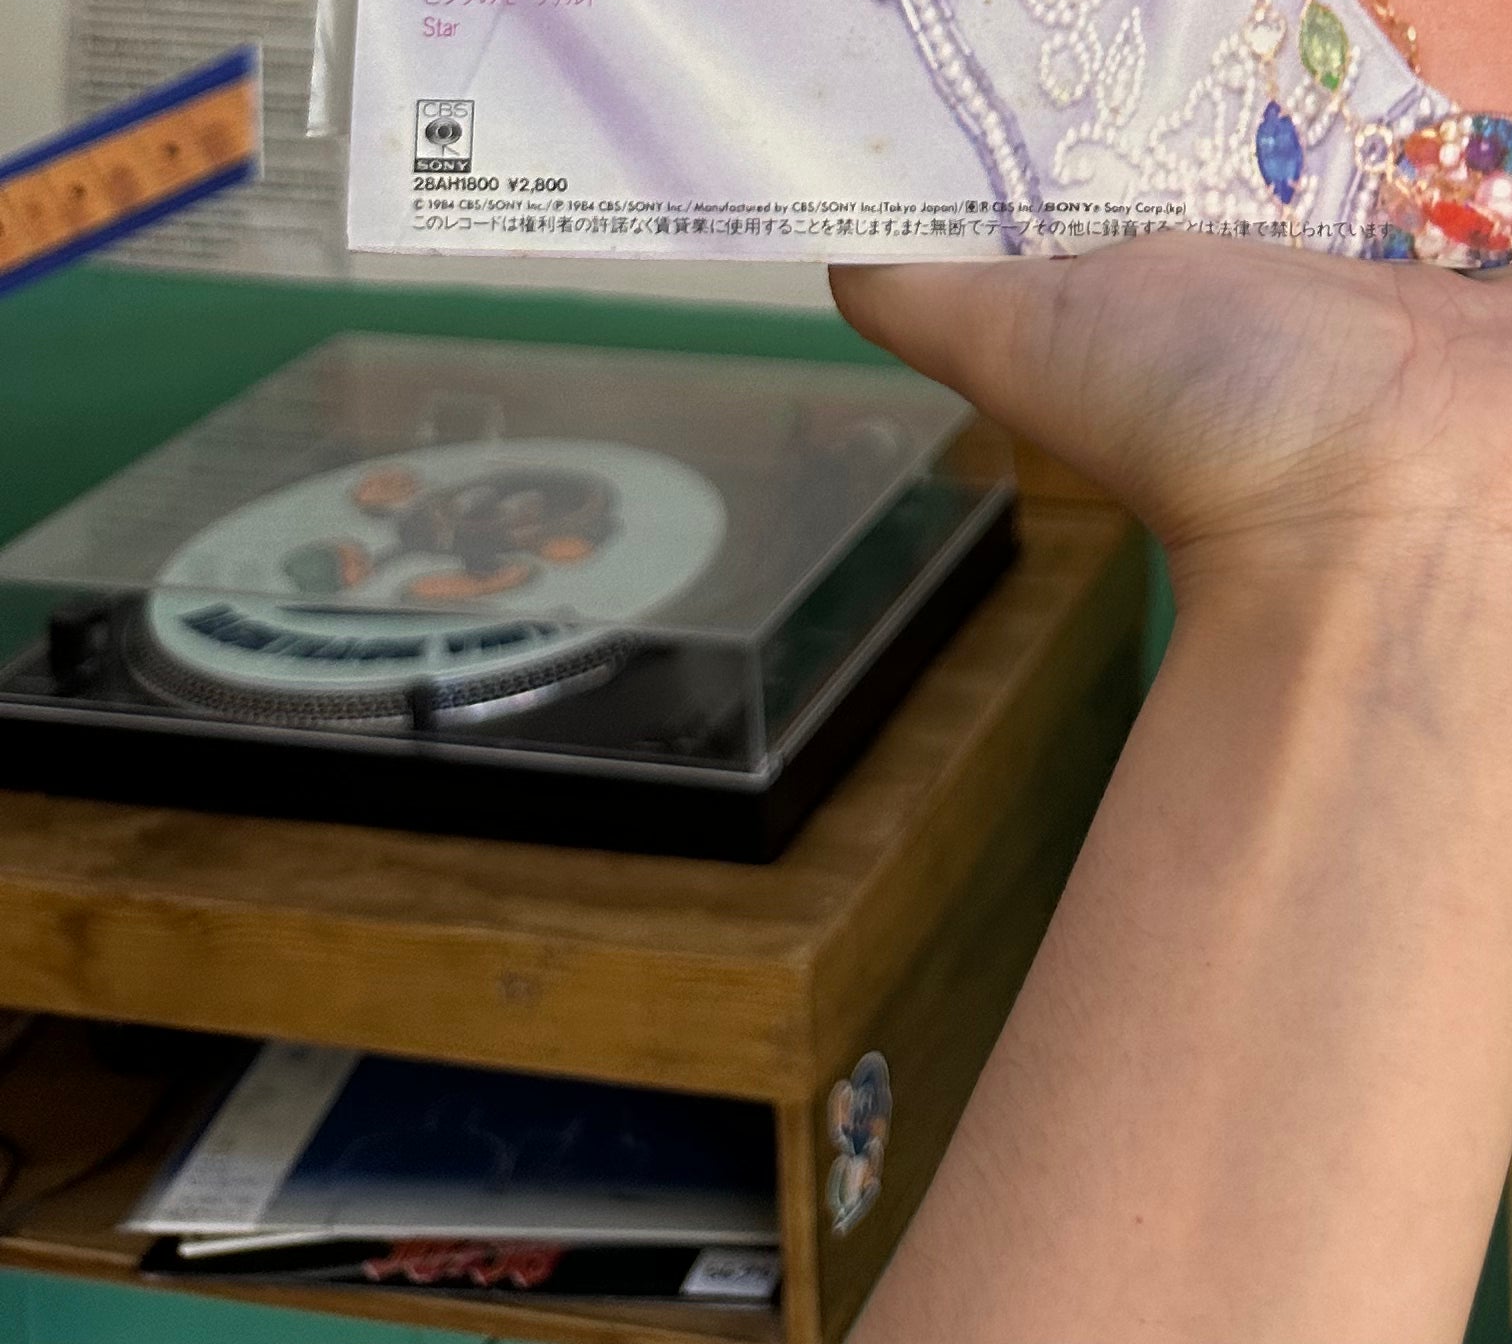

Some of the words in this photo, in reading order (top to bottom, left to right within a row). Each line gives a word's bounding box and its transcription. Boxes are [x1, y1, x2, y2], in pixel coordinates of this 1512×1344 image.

[423, 16, 460, 37] Star
[423, 102, 468, 118] CBS
[416, 160, 470, 171] SONY
[413, 176, 500, 192] 28AH1800
[508, 177, 569, 194] ¥2,800
[428, 199, 455, 210] 1984
[459, 198, 523, 211] CBS/SONY
[569, 199, 595, 211] 1984
[599, 199, 664, 213] CBS/SONY
[774, 201, 788, 214] by
[791, 201, 857, 213] CBS/SONY
[1104, 202, 1131, 215] Sony
